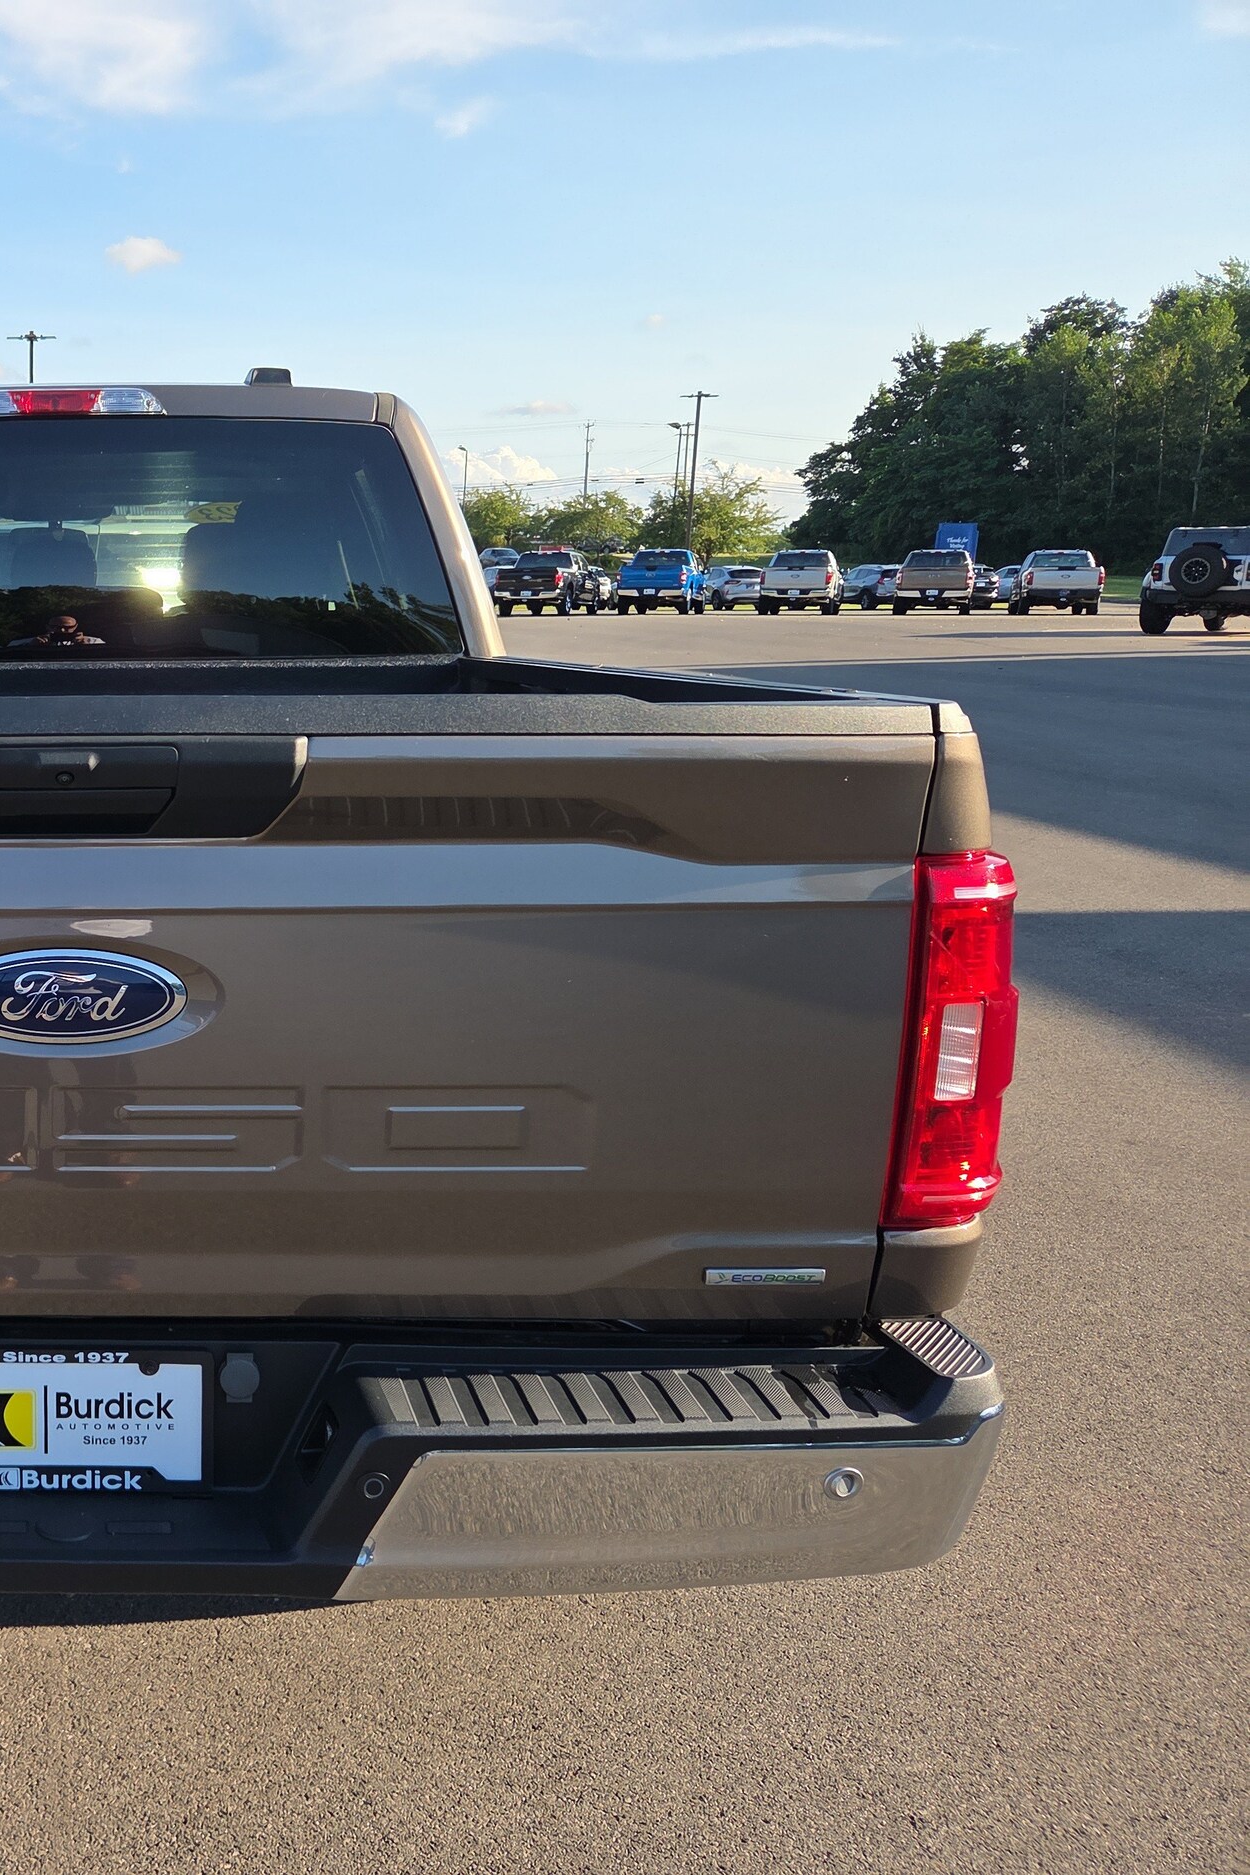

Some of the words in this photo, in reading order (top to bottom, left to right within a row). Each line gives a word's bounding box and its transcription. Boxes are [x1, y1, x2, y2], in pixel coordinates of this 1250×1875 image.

[0, 970, 129, 1021] Ford
[2, 1351, 67, 1363] Since
[74, 1352, 129, 1363] 1937
[55, 1392, 174, 1420] Burdick
[56, 1423, 175, 1431] AUTOMOTIVE
[83, 1435, 116, 1445] Since
[120, 1435, 147, 1445] 1937
[22, 1470, 142, 1490] Burdick
